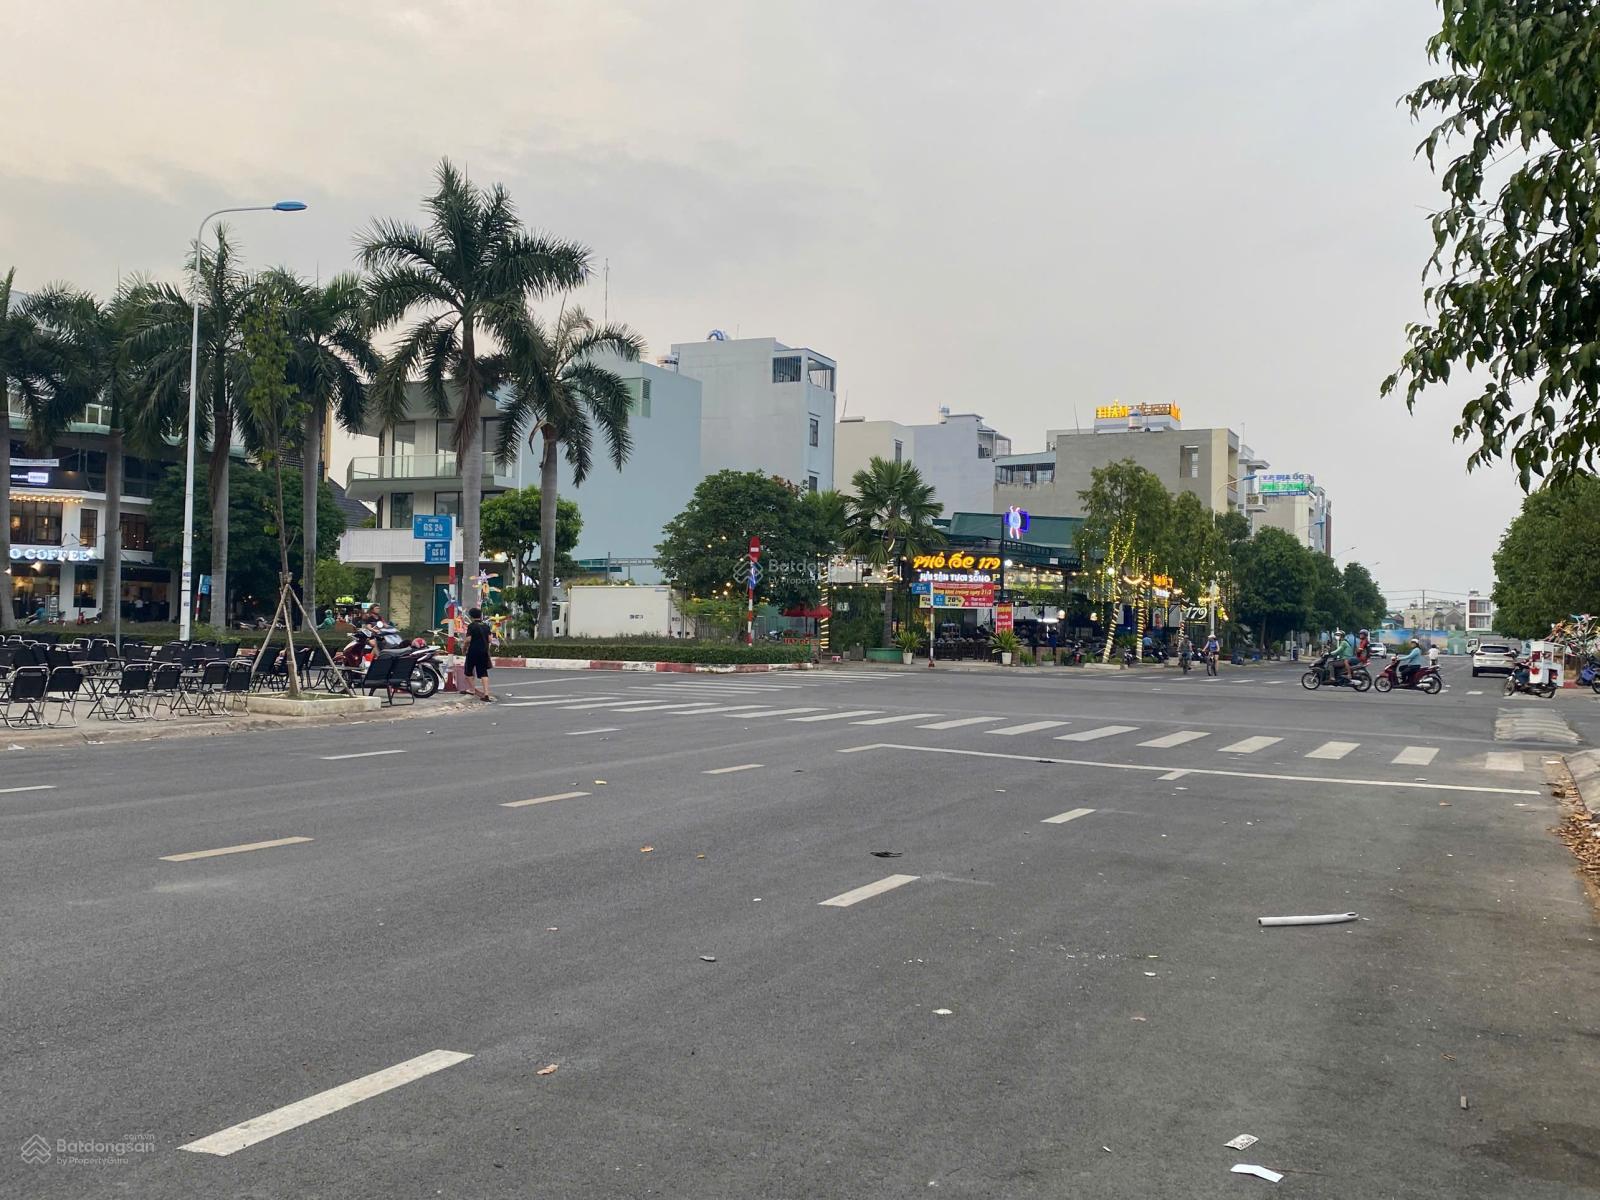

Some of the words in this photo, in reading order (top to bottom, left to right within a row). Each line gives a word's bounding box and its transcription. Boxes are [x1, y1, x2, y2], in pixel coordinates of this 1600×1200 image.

[435, 524, 443, 532] 24
[24, 548, 89, 561] COFFEE
[431, 548, 439, 556] GS
[978, 556, 1001, 569] 179
[1186, 606, 1207, 620] 179
